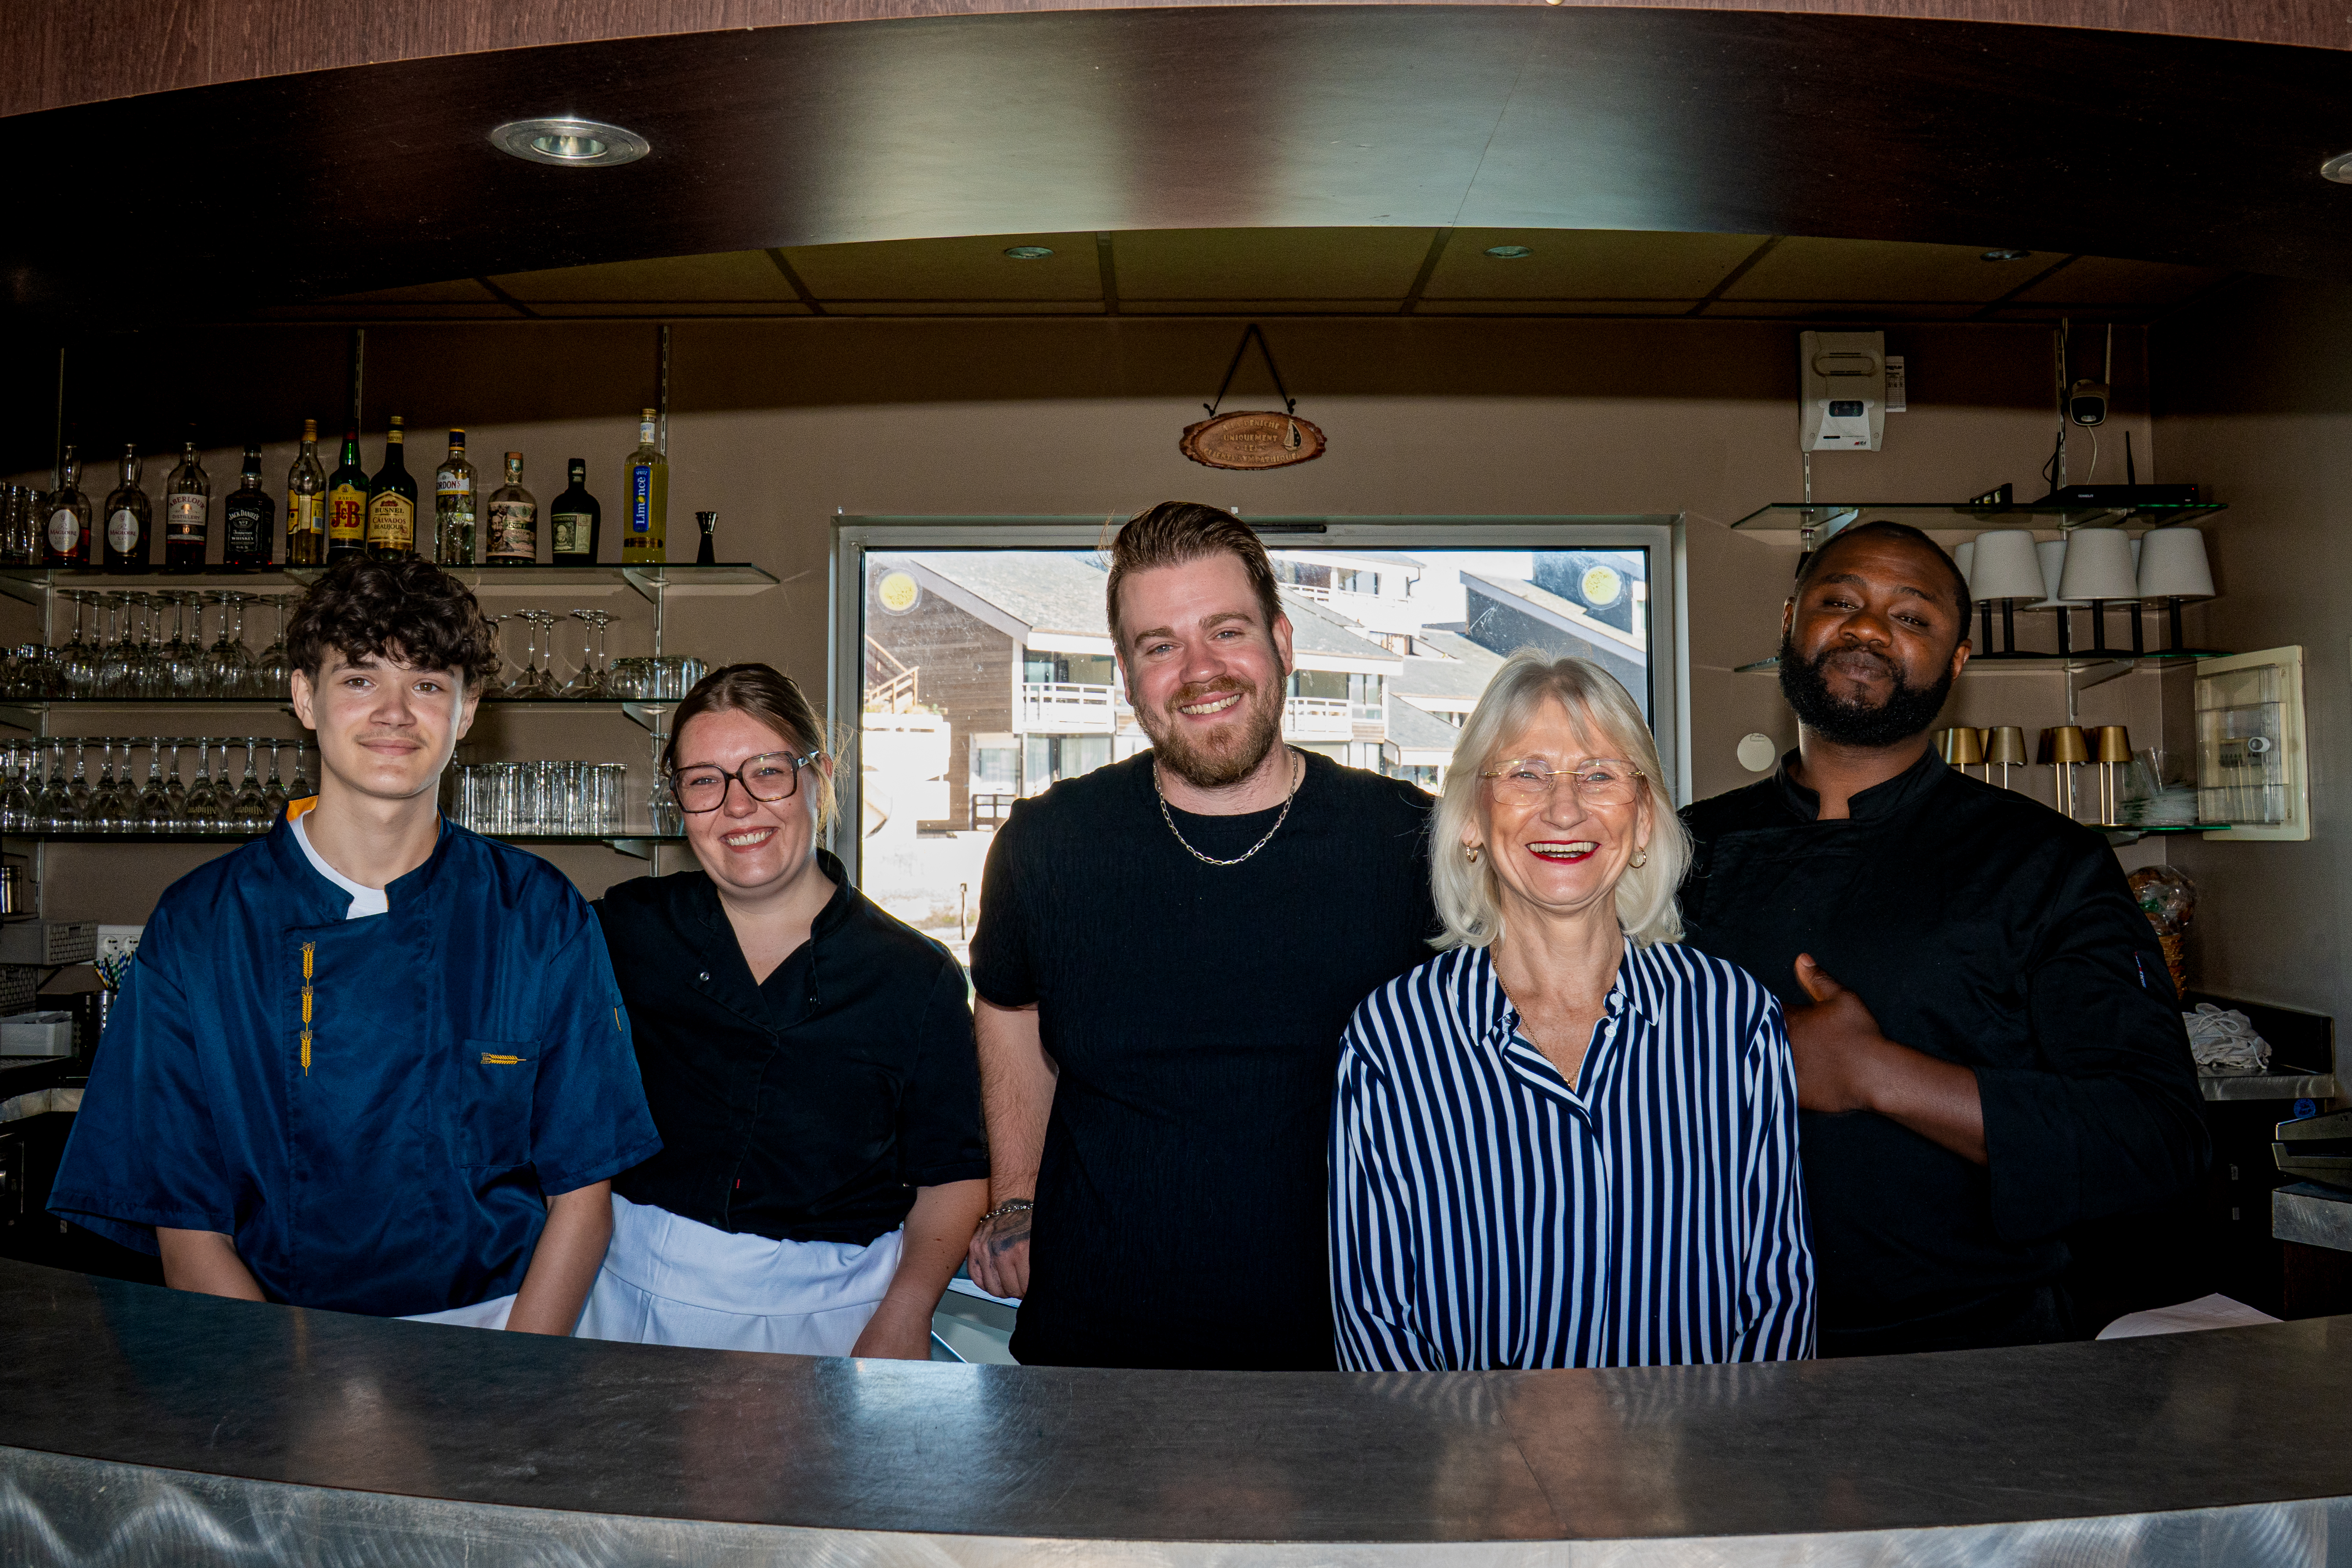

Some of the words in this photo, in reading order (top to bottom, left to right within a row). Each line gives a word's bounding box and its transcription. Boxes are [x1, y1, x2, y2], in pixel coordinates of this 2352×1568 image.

[1223, 433, 1278, 442] UNIQUEMENT
[1203, 448, 1235, 461] CLIENTS
[1238, 453, 1300, 463] SYMPATHIQUES
[437, 480, 461, 490] ORDON'S
[169, 496, 205, 509] ABERLOUR
[228, 511, 241, 521] JACK
[240, 509, 260, 521] DANIEL'S
[331, 501, 360, 528] J&B
